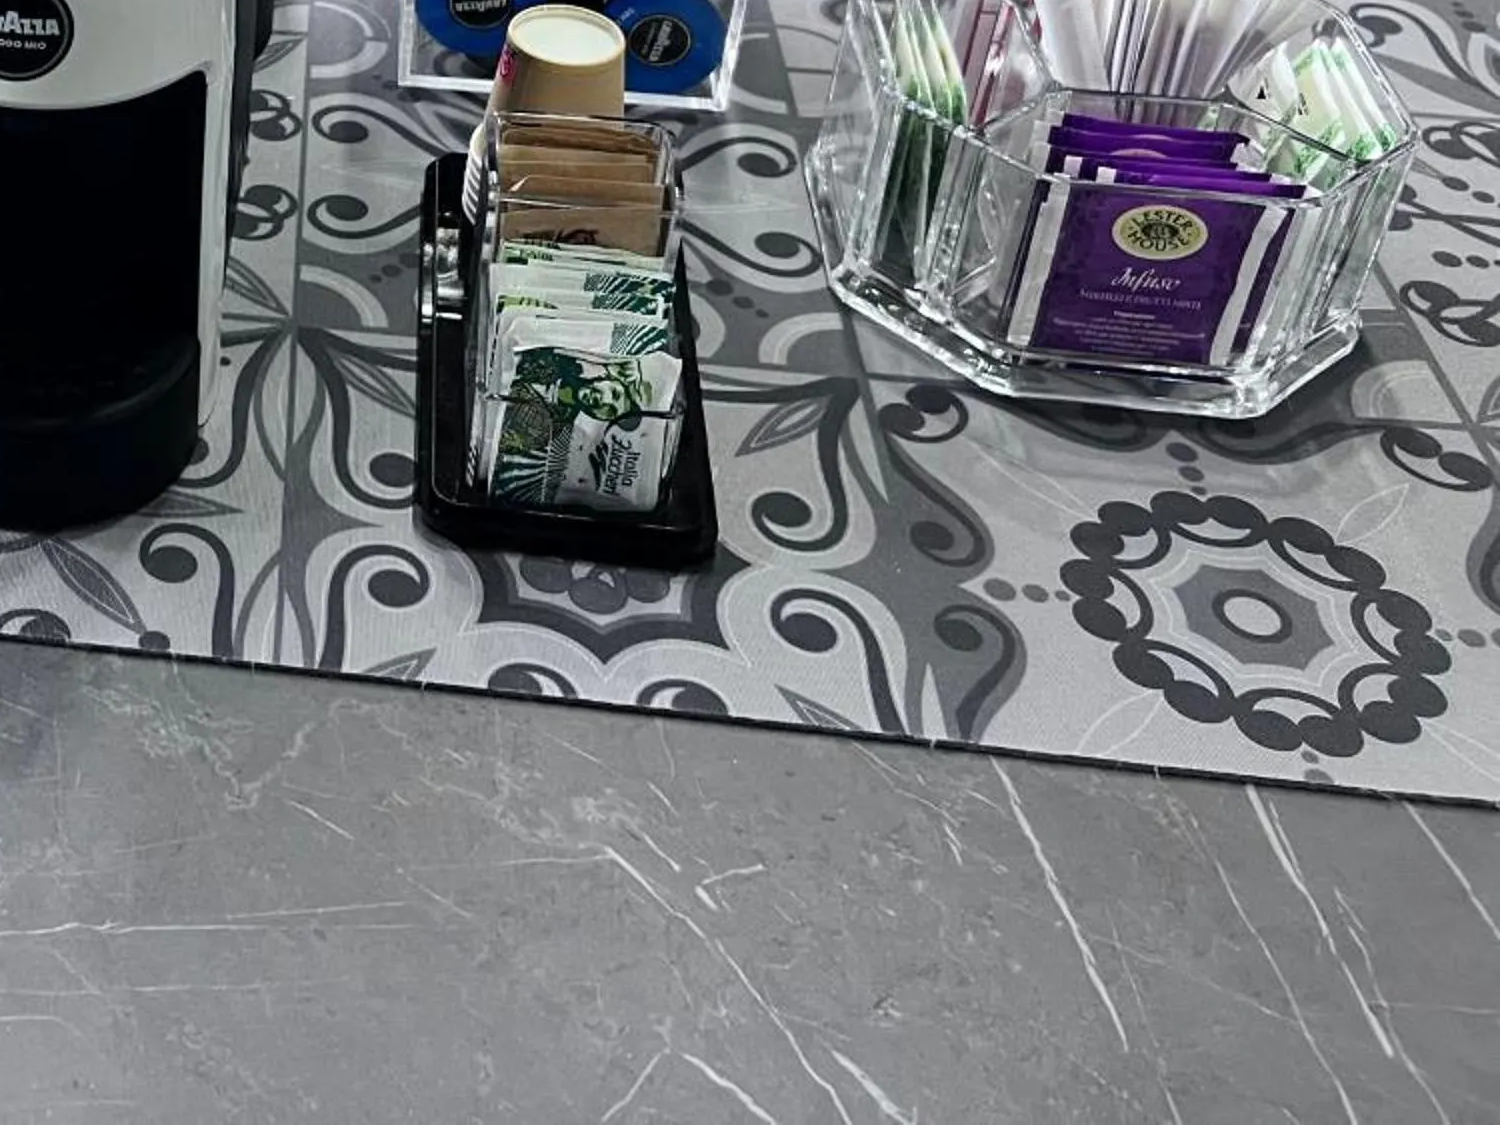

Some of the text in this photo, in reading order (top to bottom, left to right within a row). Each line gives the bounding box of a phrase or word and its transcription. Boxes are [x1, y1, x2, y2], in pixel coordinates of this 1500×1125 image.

[1131, 210, 1193, 231] LESTER
[1127, 230, 1190, 252] HOUSE
[621, 452, 641, 487] Italia
